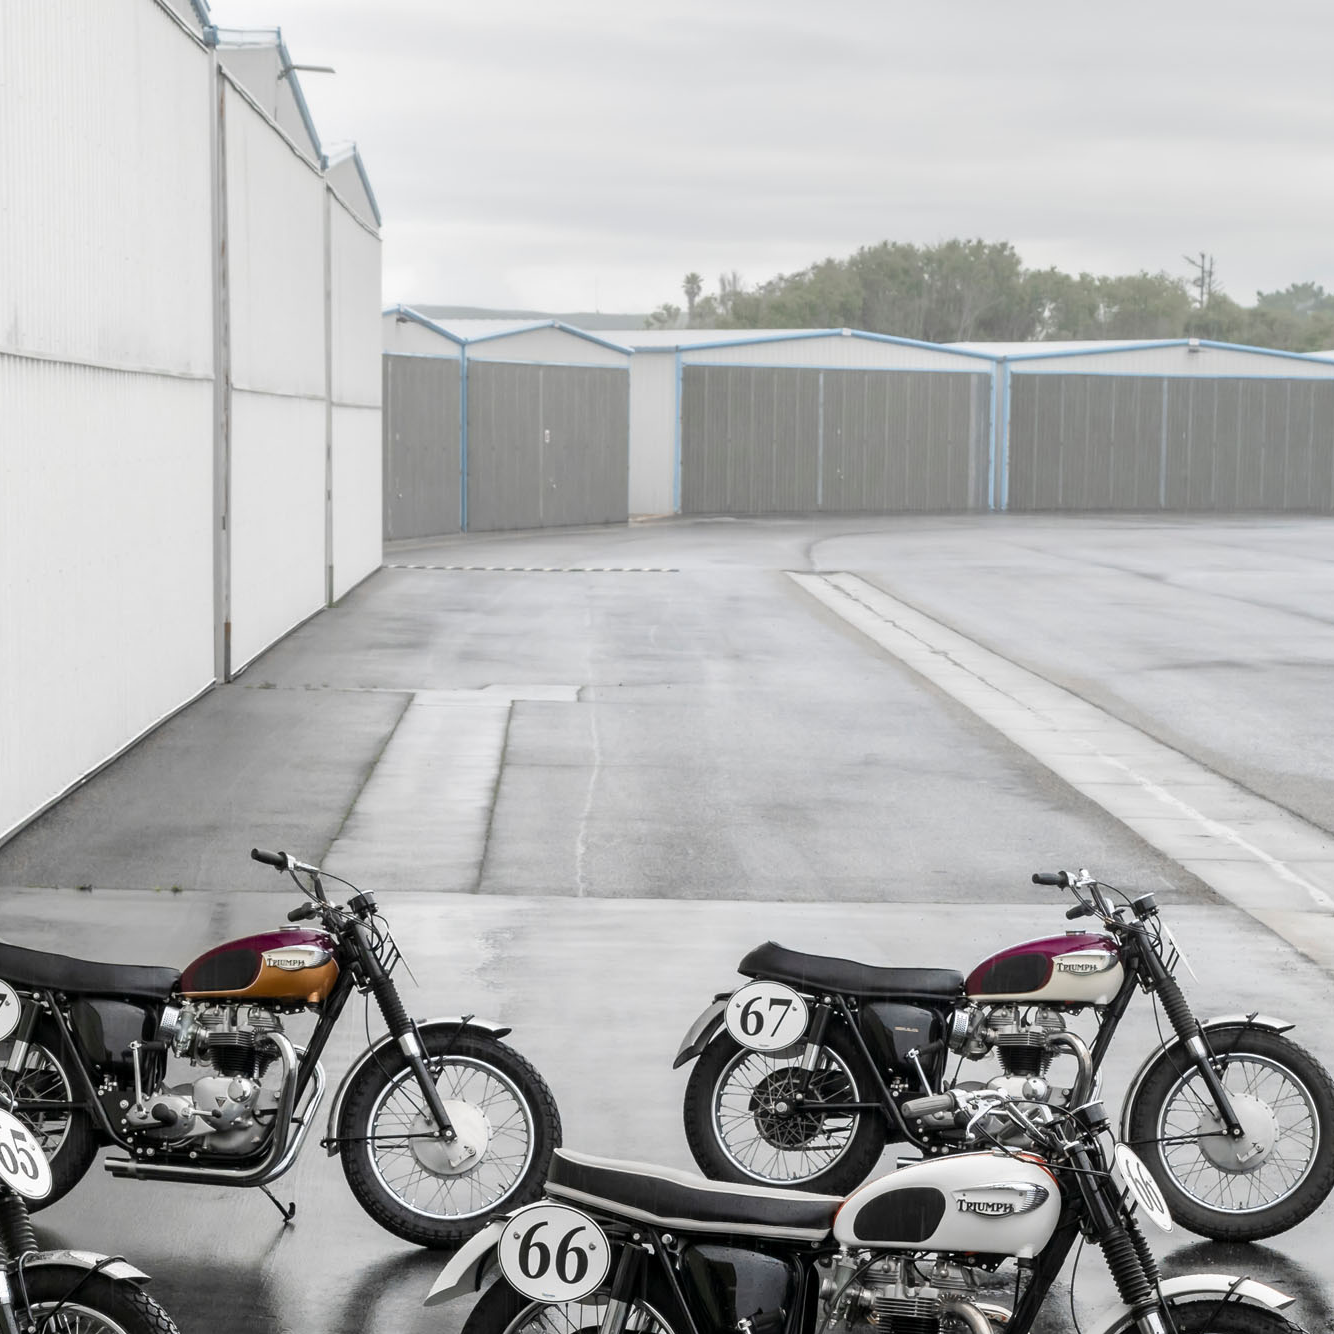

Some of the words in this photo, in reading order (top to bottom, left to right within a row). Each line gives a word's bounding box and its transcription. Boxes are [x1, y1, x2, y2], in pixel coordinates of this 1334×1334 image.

[267, 958, 305, 970] TRIUMPH
[1057, 963, 1098, 976] TRIUMPH
[740, 997, 793, 1037] 67
[1126, 1158, 1165, 1215] 66
[957, 1199, 1014, 1219] TRIUMPH
[519, 1221, 589, 1284] 66
